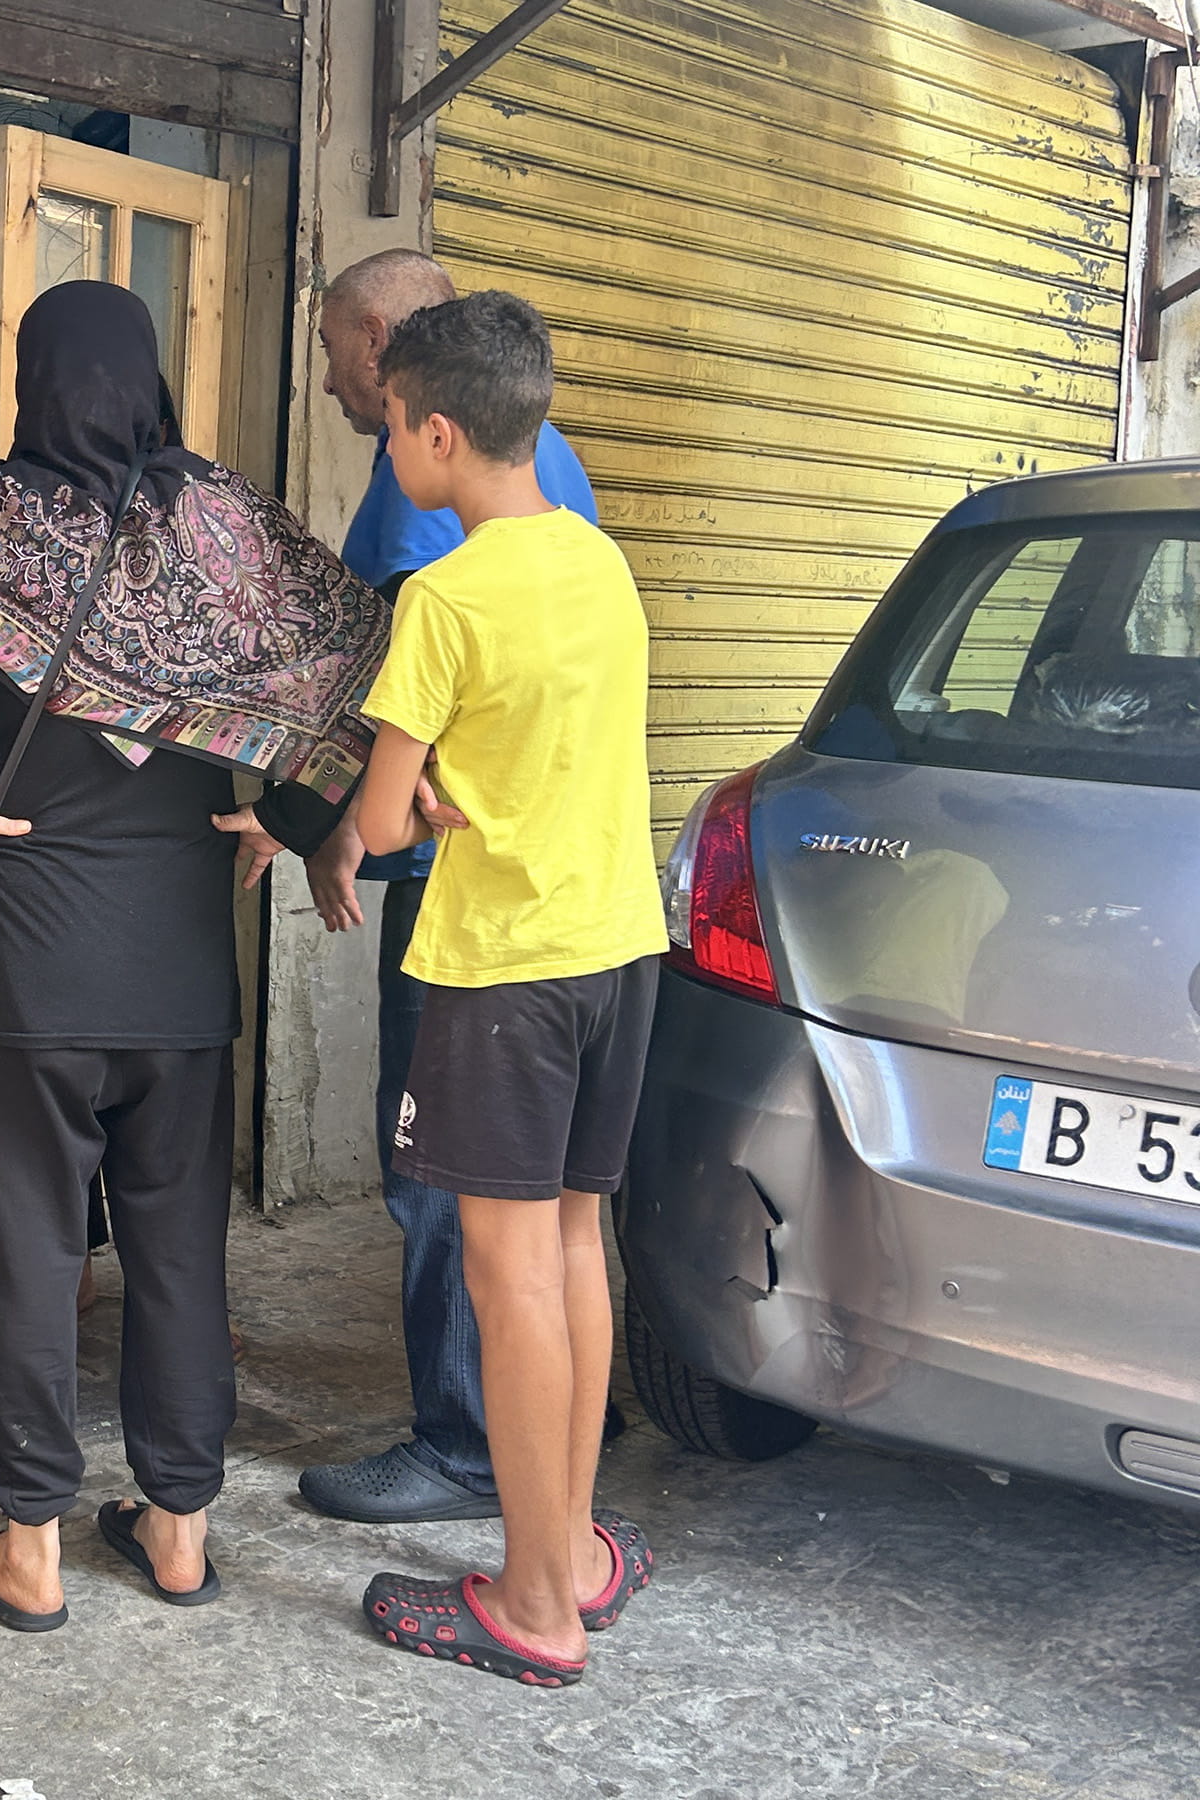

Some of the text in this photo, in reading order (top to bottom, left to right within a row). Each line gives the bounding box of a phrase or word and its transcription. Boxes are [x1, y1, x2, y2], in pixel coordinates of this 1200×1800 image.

[799, 833, 912, 860] SUZUKI
[997, 1085, 1031, 1104] لبنان
[1045, 1096, 1090, 1167] B
